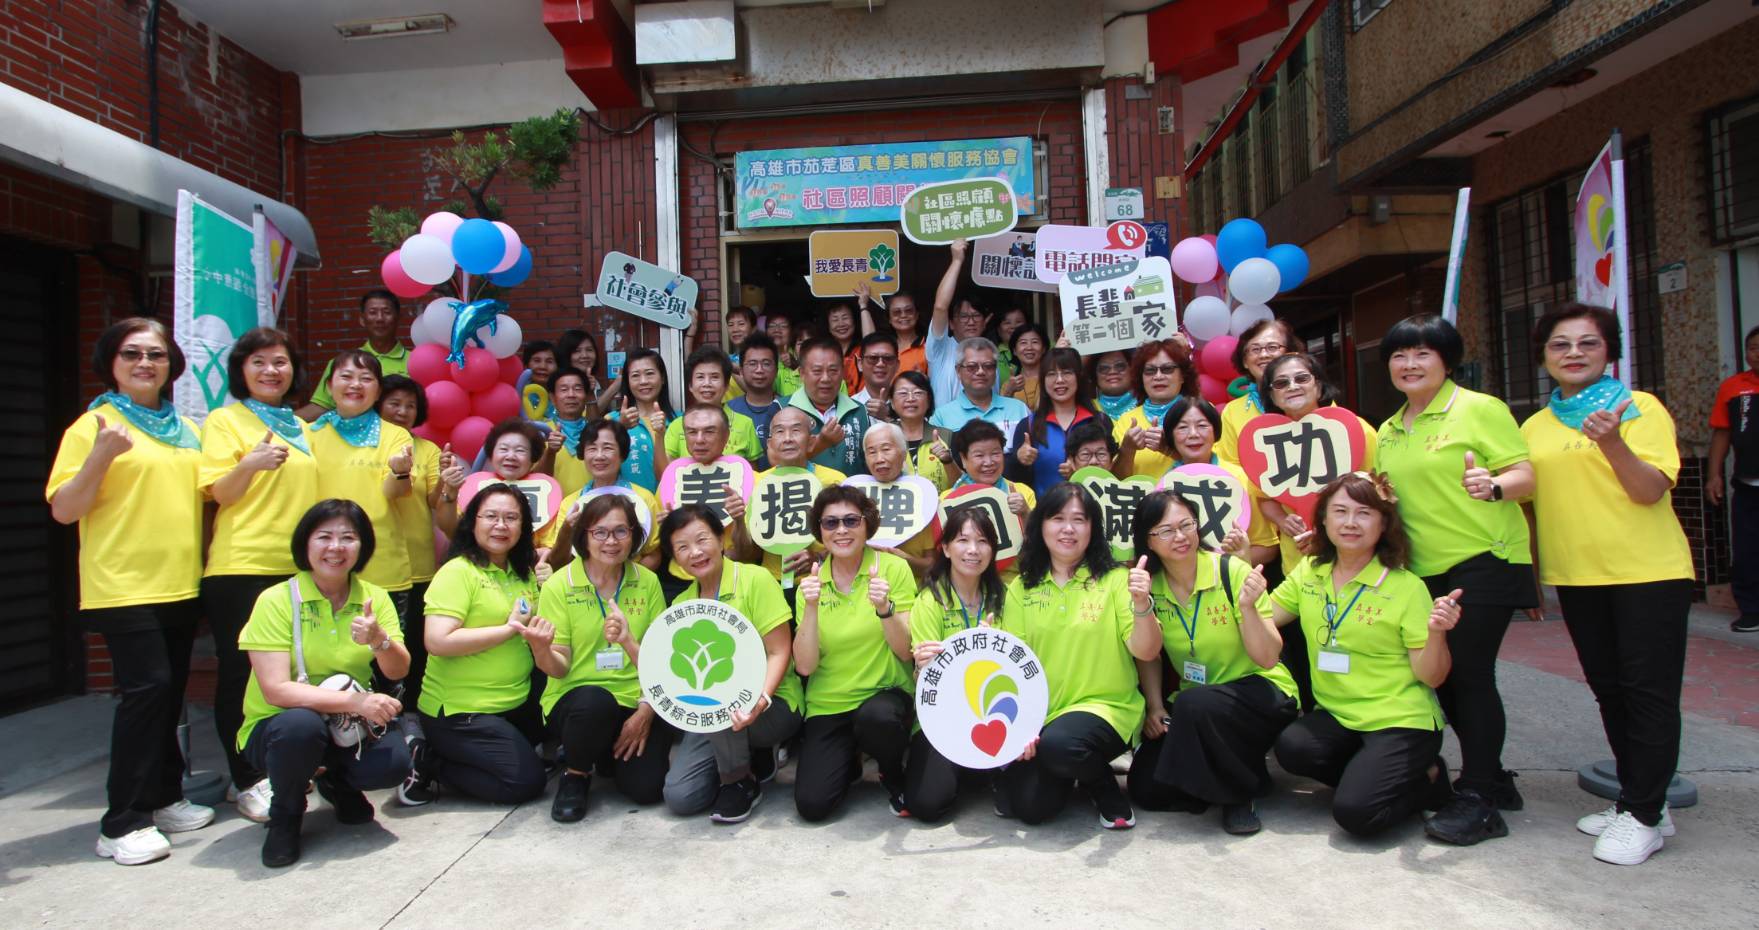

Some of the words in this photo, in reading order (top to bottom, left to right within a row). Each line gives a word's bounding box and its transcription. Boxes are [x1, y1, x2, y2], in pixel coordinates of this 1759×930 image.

[924, 187, 994, 209] 社區照顧
[1117, 204, 1133, 216] 68
[815, 258, 867, 273] 我愛長青
[1074, 265, 1130, 281] welcome
[606, 275, 687, 319] 社會參與
[1669, 278, 1677, 289] 2
[1076, 288, 1121, 320] 長輩
[1132, 301, 1166, 338] 家
[1263, 422, 1338, 488] 功
[761, 479, 813, 539] 揭
[664, 603, 749, 635] 高雄市政府社會局
[921, 633, 1039, 706] 高雄市政府社會局
